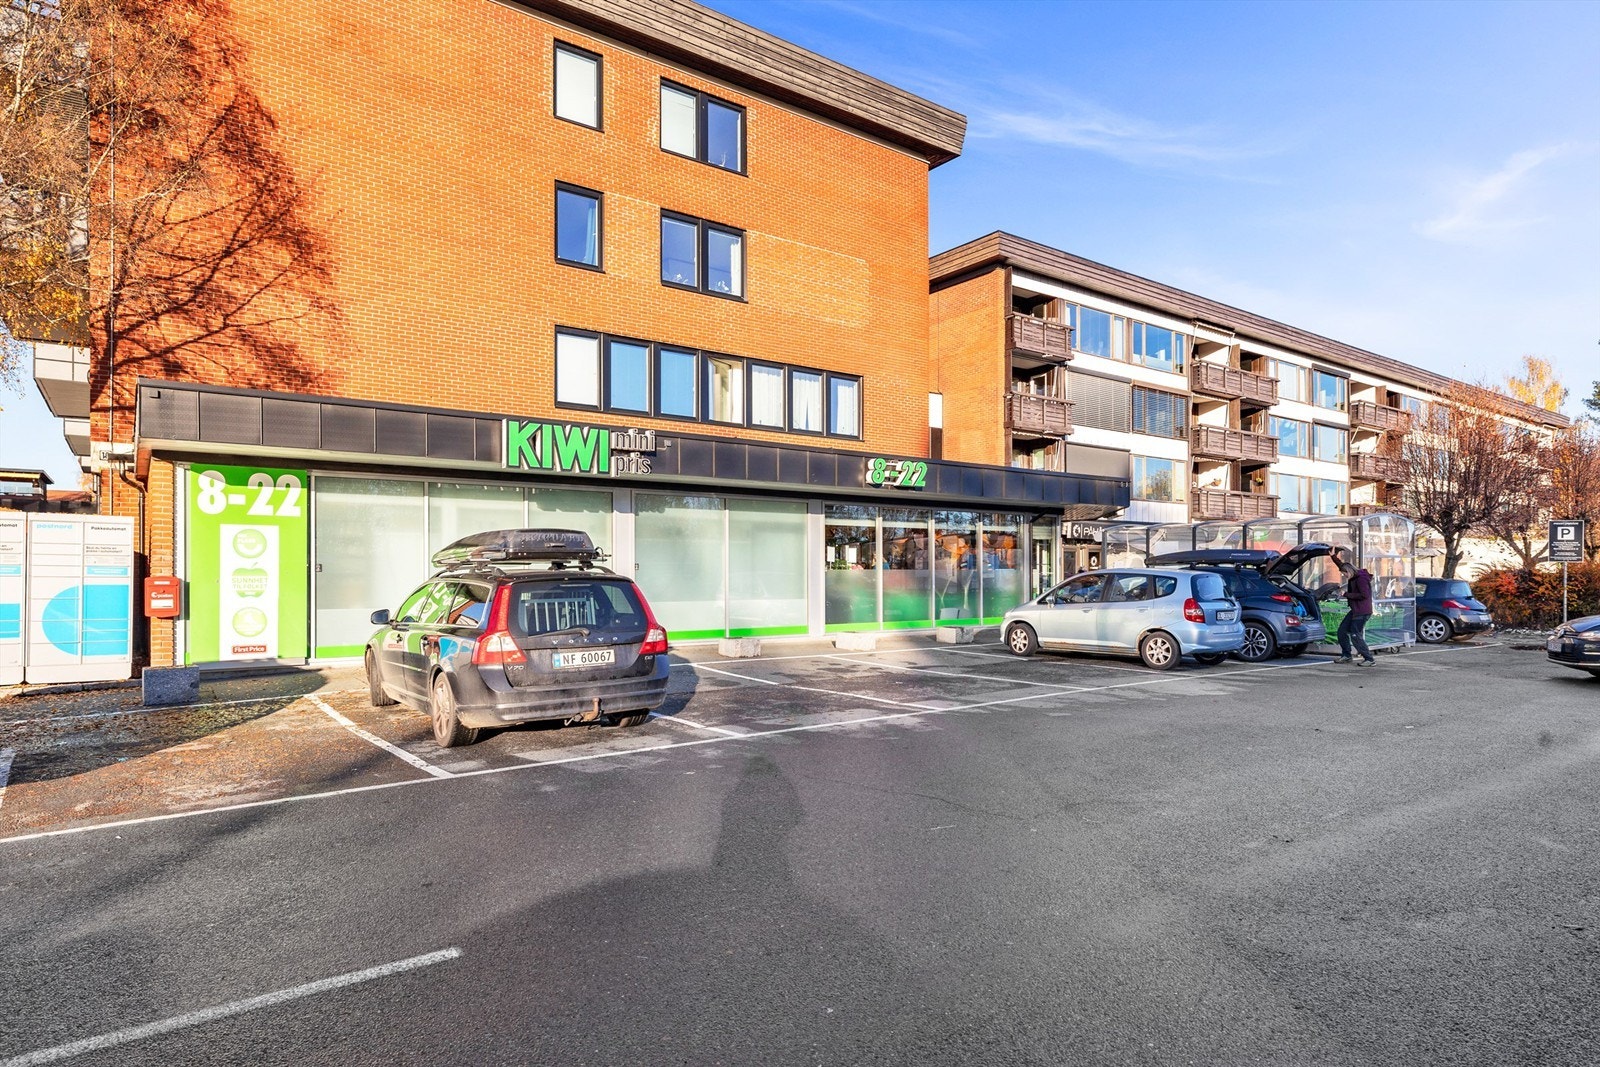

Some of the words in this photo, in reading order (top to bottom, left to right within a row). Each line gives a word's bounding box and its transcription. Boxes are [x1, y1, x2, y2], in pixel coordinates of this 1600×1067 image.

[506, 419, 611, 473] KIWI
[614, 429, 657, 451] mini
[614, 452, 652, 477] pris
[870, 457, 928, 487] 8-22
[197, 469, 302, 517] 8-22
[1560, 528, 1571, 539] P
[551, 636, 618, 645] VOLVO
[562, 654, 576, 665] NF
[580, 651, 612, 664] 60067
